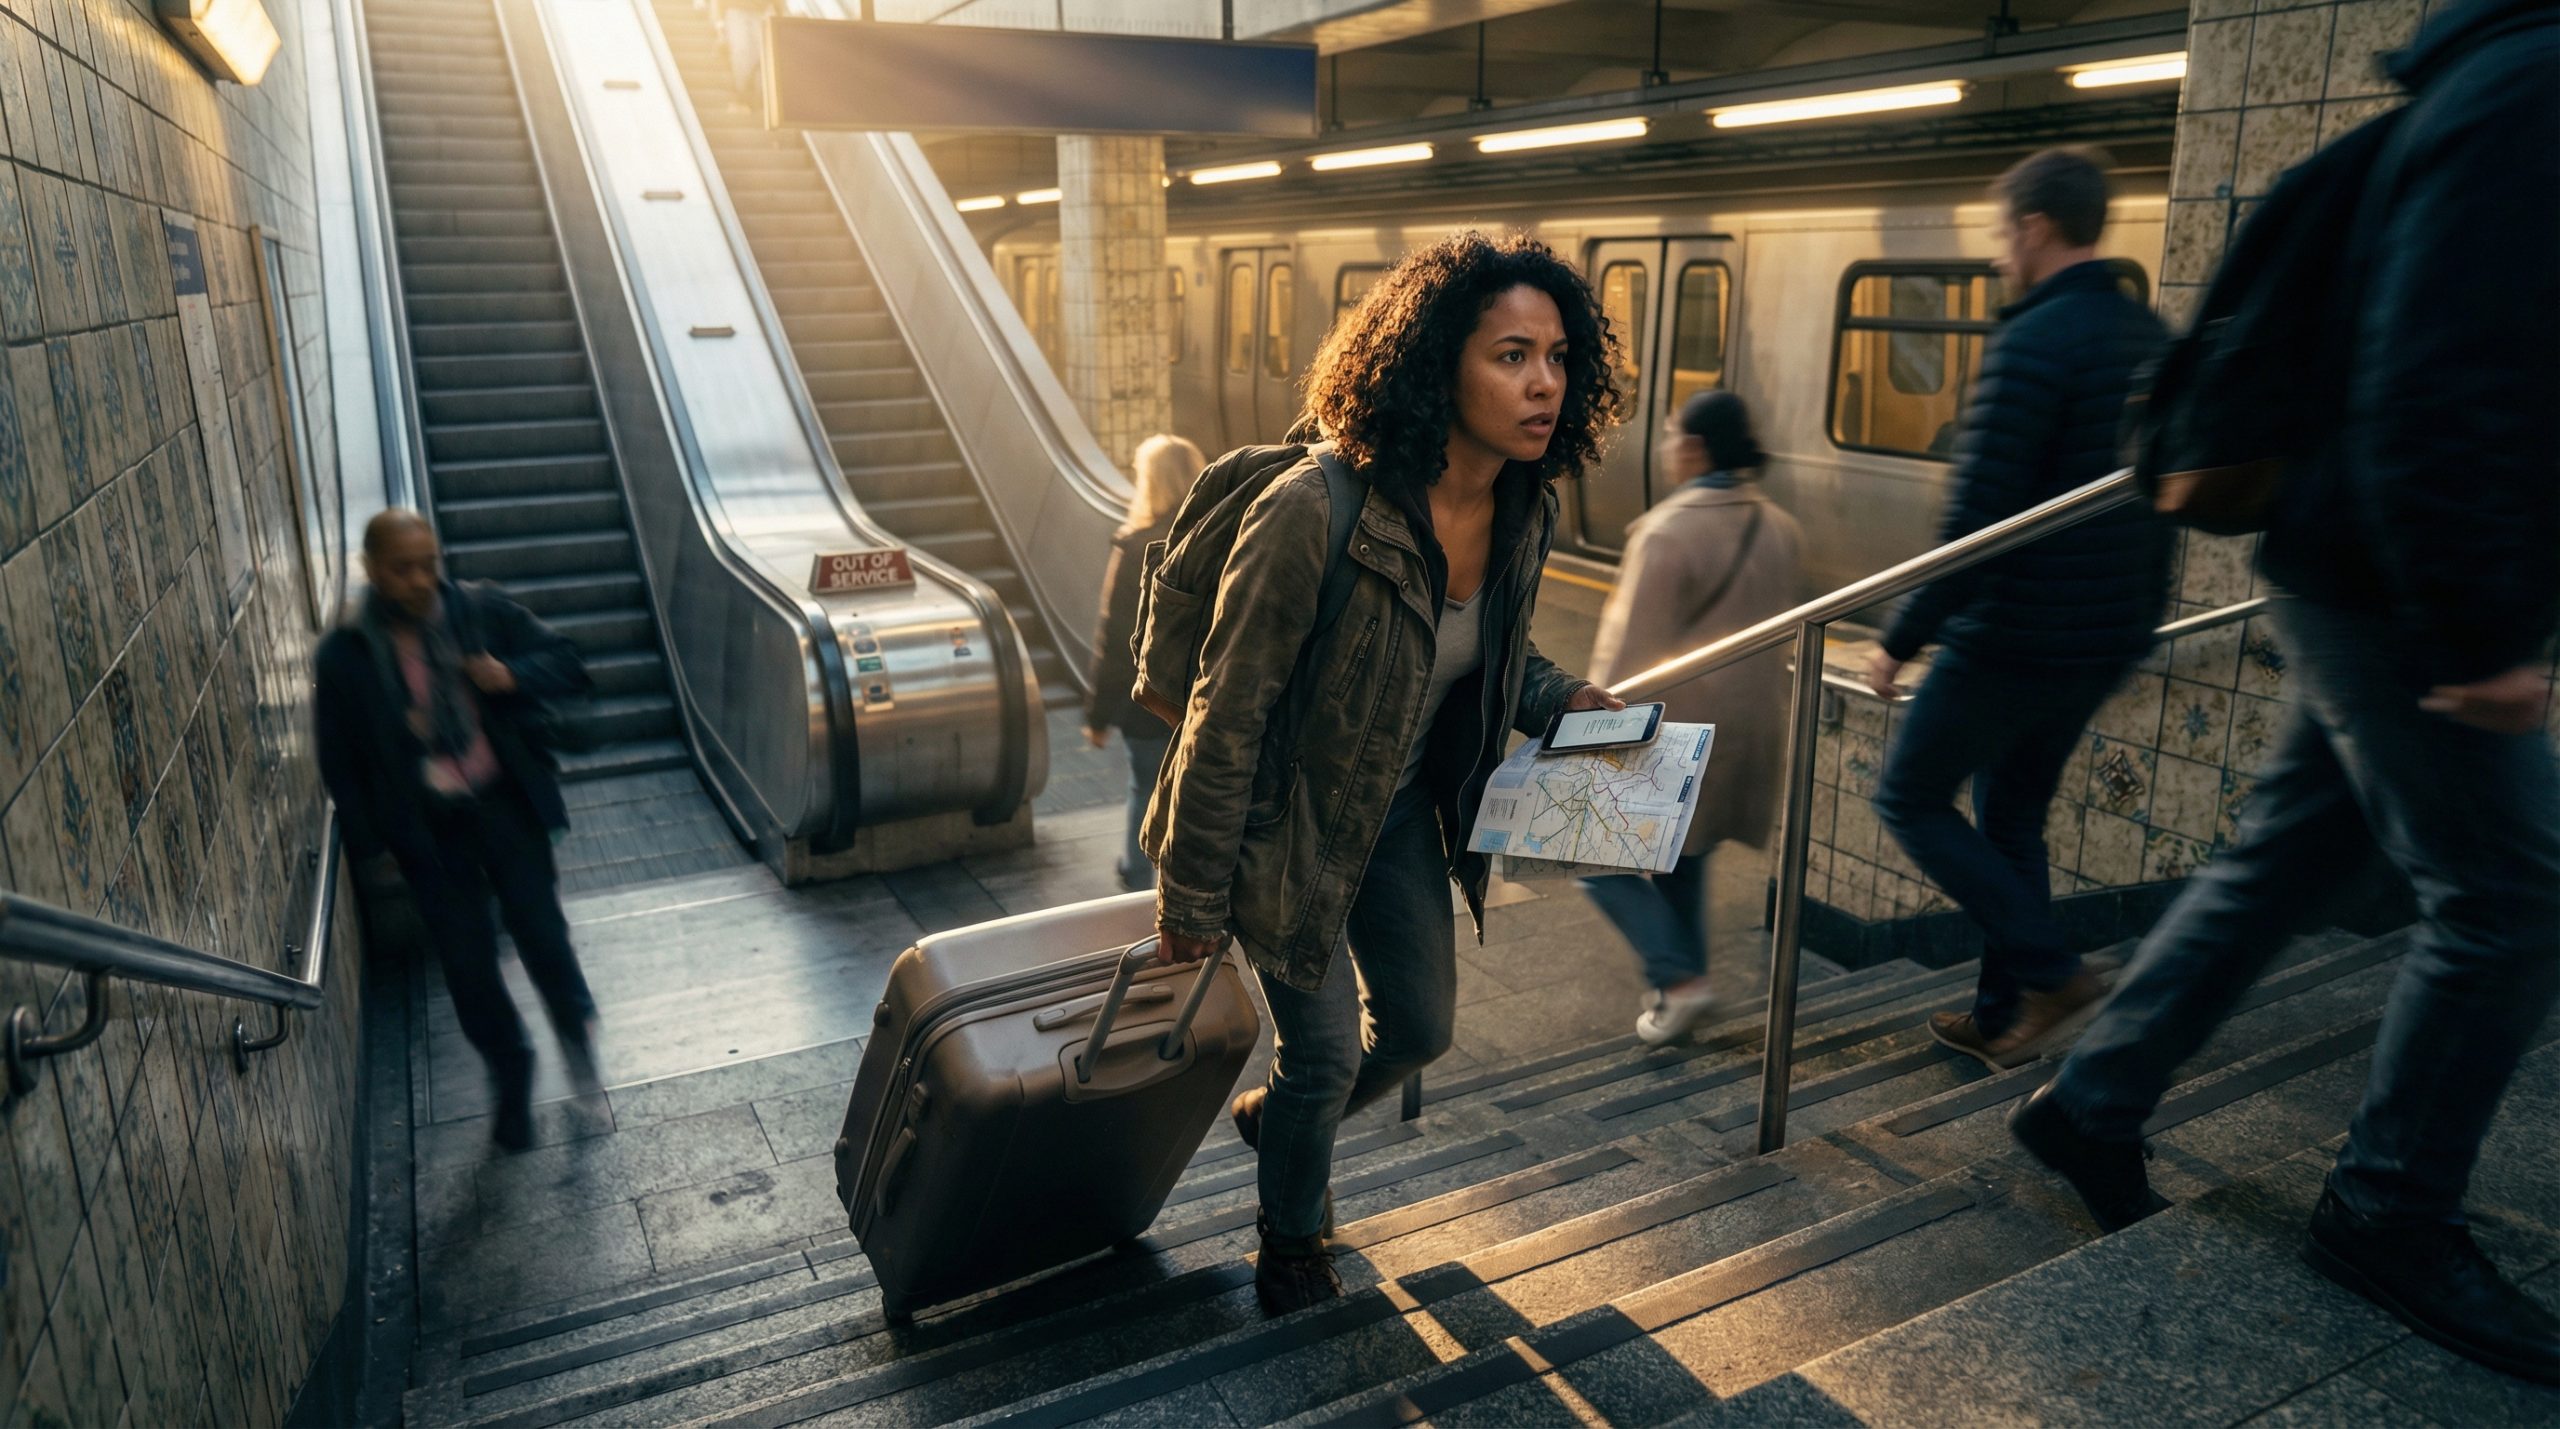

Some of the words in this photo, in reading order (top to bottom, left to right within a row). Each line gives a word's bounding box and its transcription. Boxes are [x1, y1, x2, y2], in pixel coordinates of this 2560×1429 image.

[832, 555, 867, 572] OUT
[870, 552, 893, 568] OF
[830, 567, 898, 587] SERVICE
